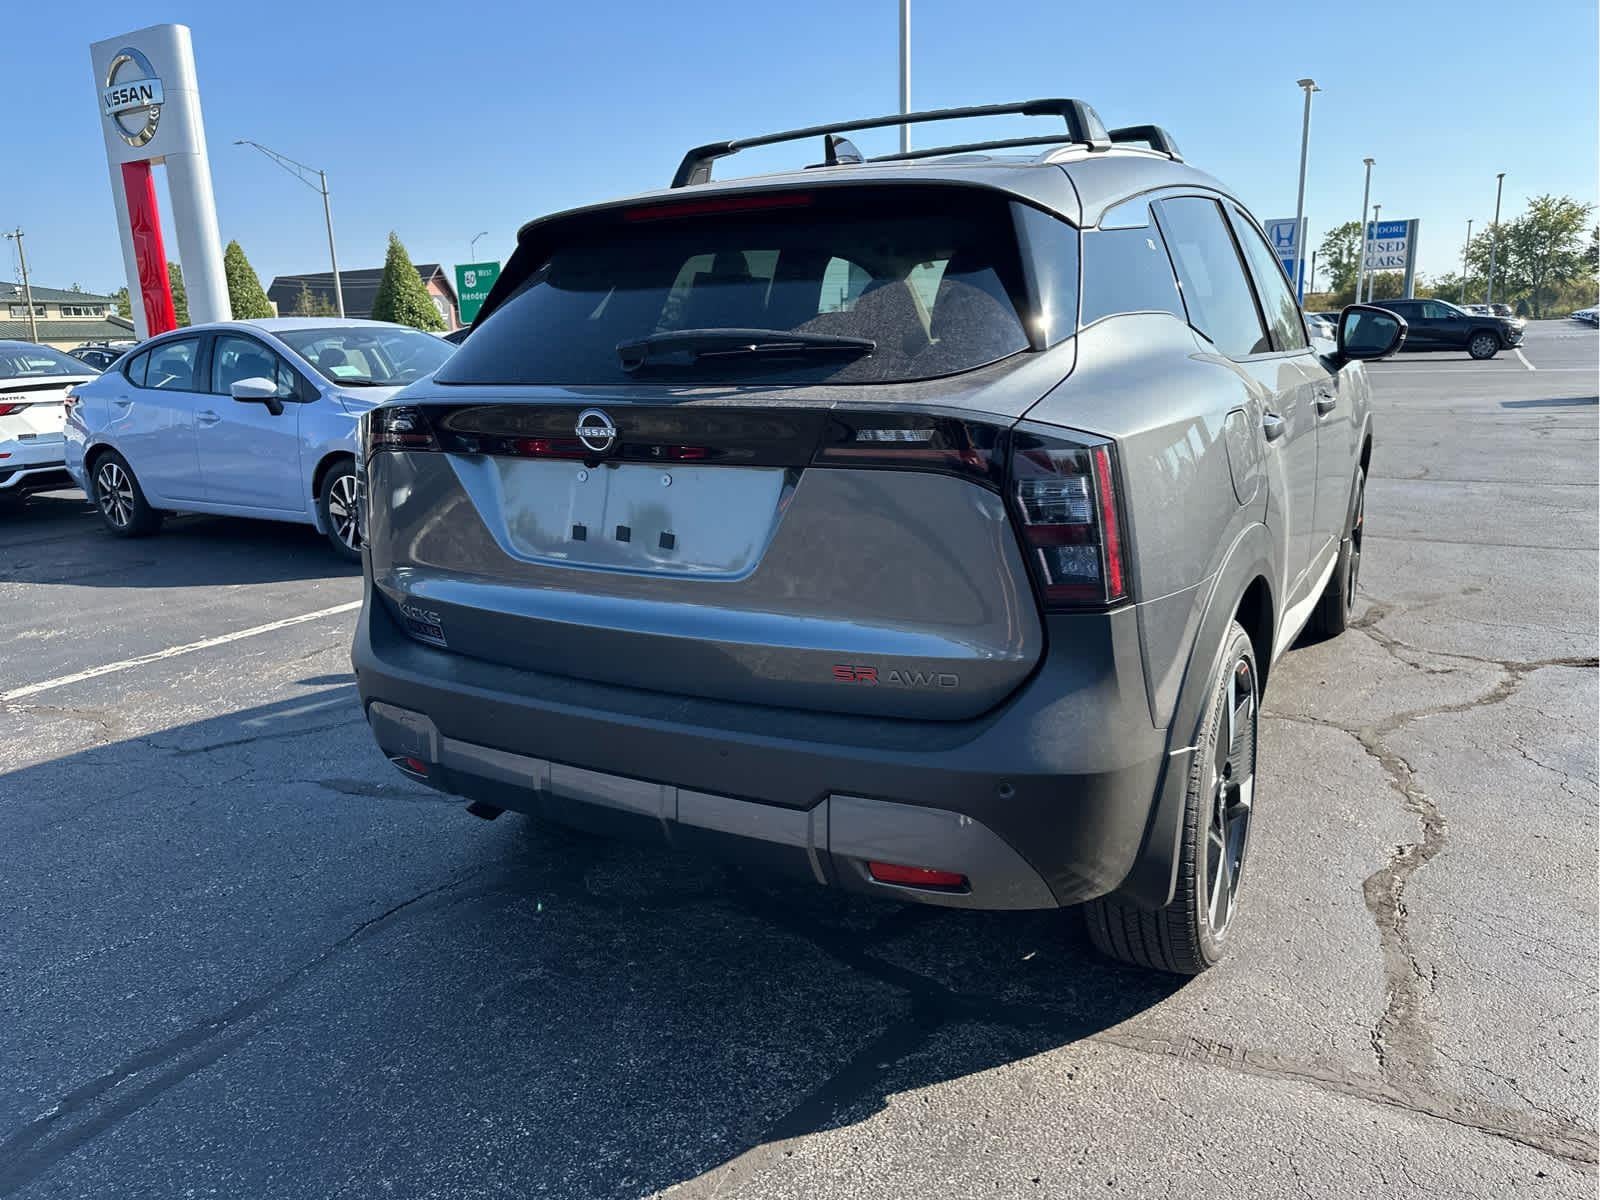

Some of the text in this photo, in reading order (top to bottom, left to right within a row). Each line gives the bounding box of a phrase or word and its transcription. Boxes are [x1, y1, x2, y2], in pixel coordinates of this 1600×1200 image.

[104, 84, 153, 108] NISSAN
[1366, 256, 1404, 266] CARS
[461, 292, 489, 300] Hender
[575, 428, 616, 437] NISSAN
[399, 602, 441, 624] KICKS
[831, 664, 960, 688] SR AWD
